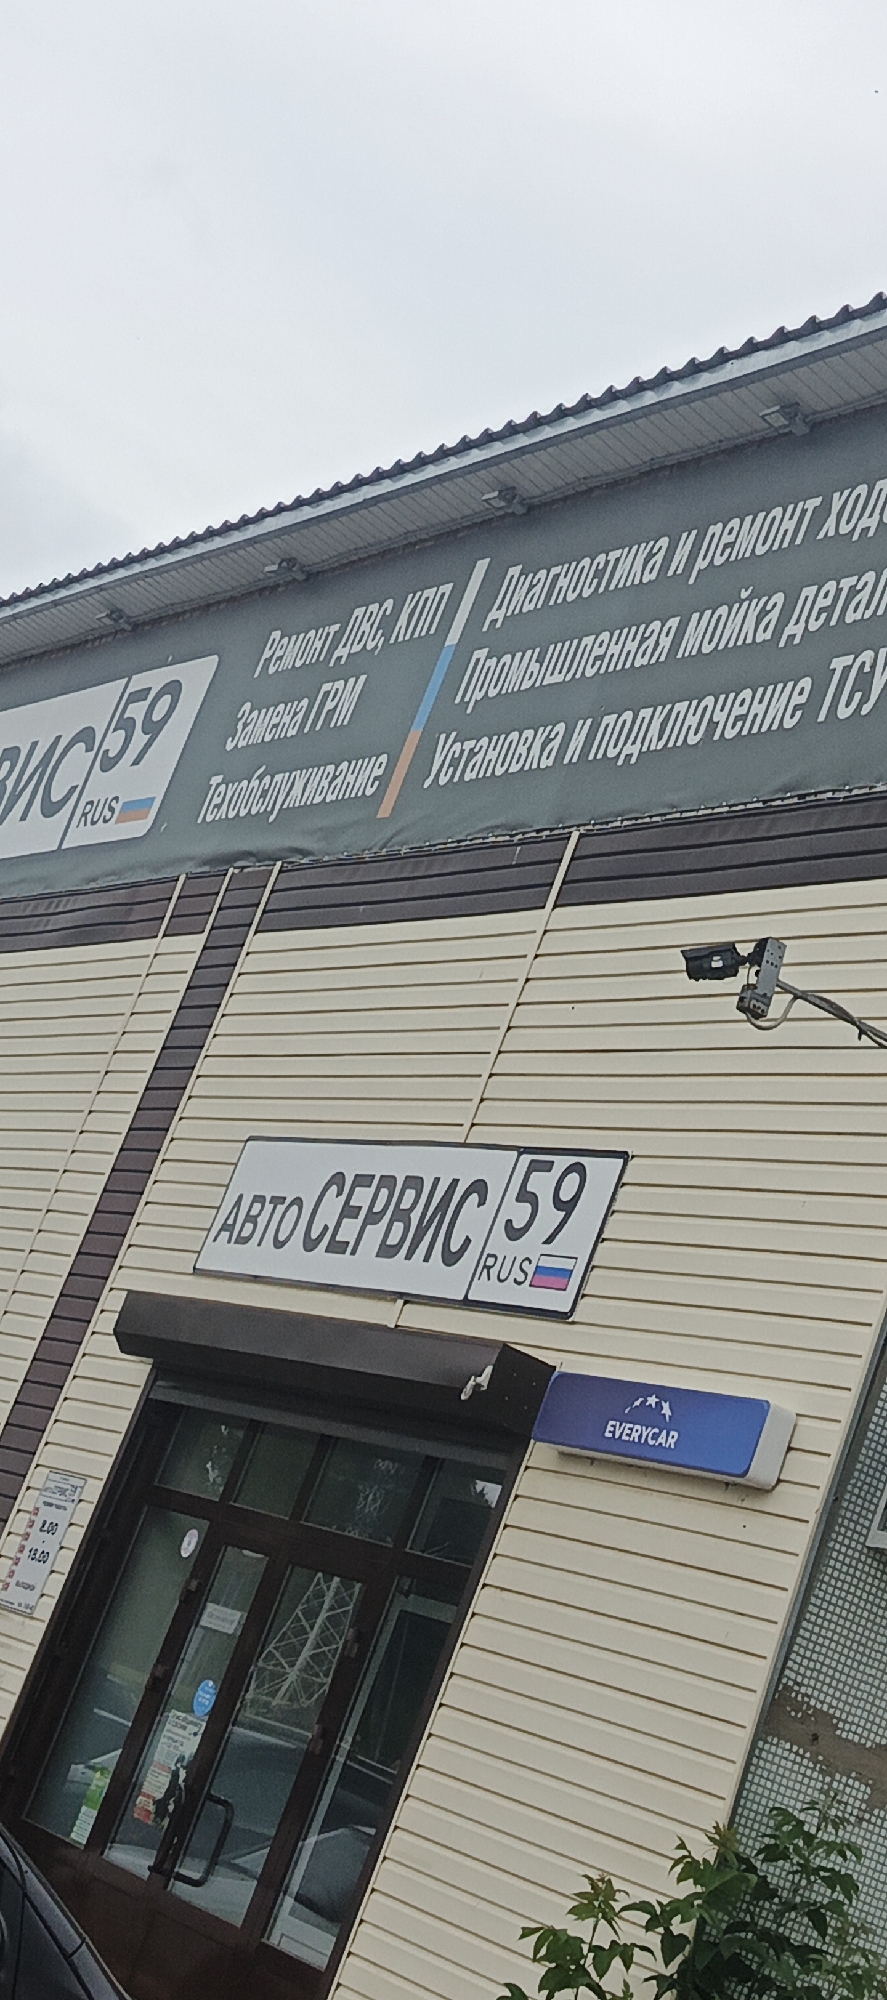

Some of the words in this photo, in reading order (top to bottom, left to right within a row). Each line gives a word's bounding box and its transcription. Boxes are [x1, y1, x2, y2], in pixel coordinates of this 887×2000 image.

[482, 536, 669, 632] Диагностика
[668, 529, 698, 577] и
[689, 496, 822, 584] ремонт
[816, 478, 887, 542] ход
[253, 623, 342, 678] Ремонт
[329, 598, 394, 656] ДВС,
[389, 582, 454, 643] КПП
[454, 616, 680, 714] Промышленная
[677, 586, 785, 659] мойка
[100, 679, 183, 773] 59
[225, 697, 310, 751] Замена
[315, 674, 368, 731] ГРМ
[423, 722, 565, 789] Установка
[564, 716, 593, 764] и
[588, 675, 812, 767] подключение
[816, 647, 887, 723] ТСУ
[76, 796, 120, 828] RUS
[197, 753, 388, 824] Техобслуживание
[504, 1159, 587, 1246] 59
[477, 1253, 533, 1286] RUS
[604, 1420, 679, 1449] EVERYCAR
